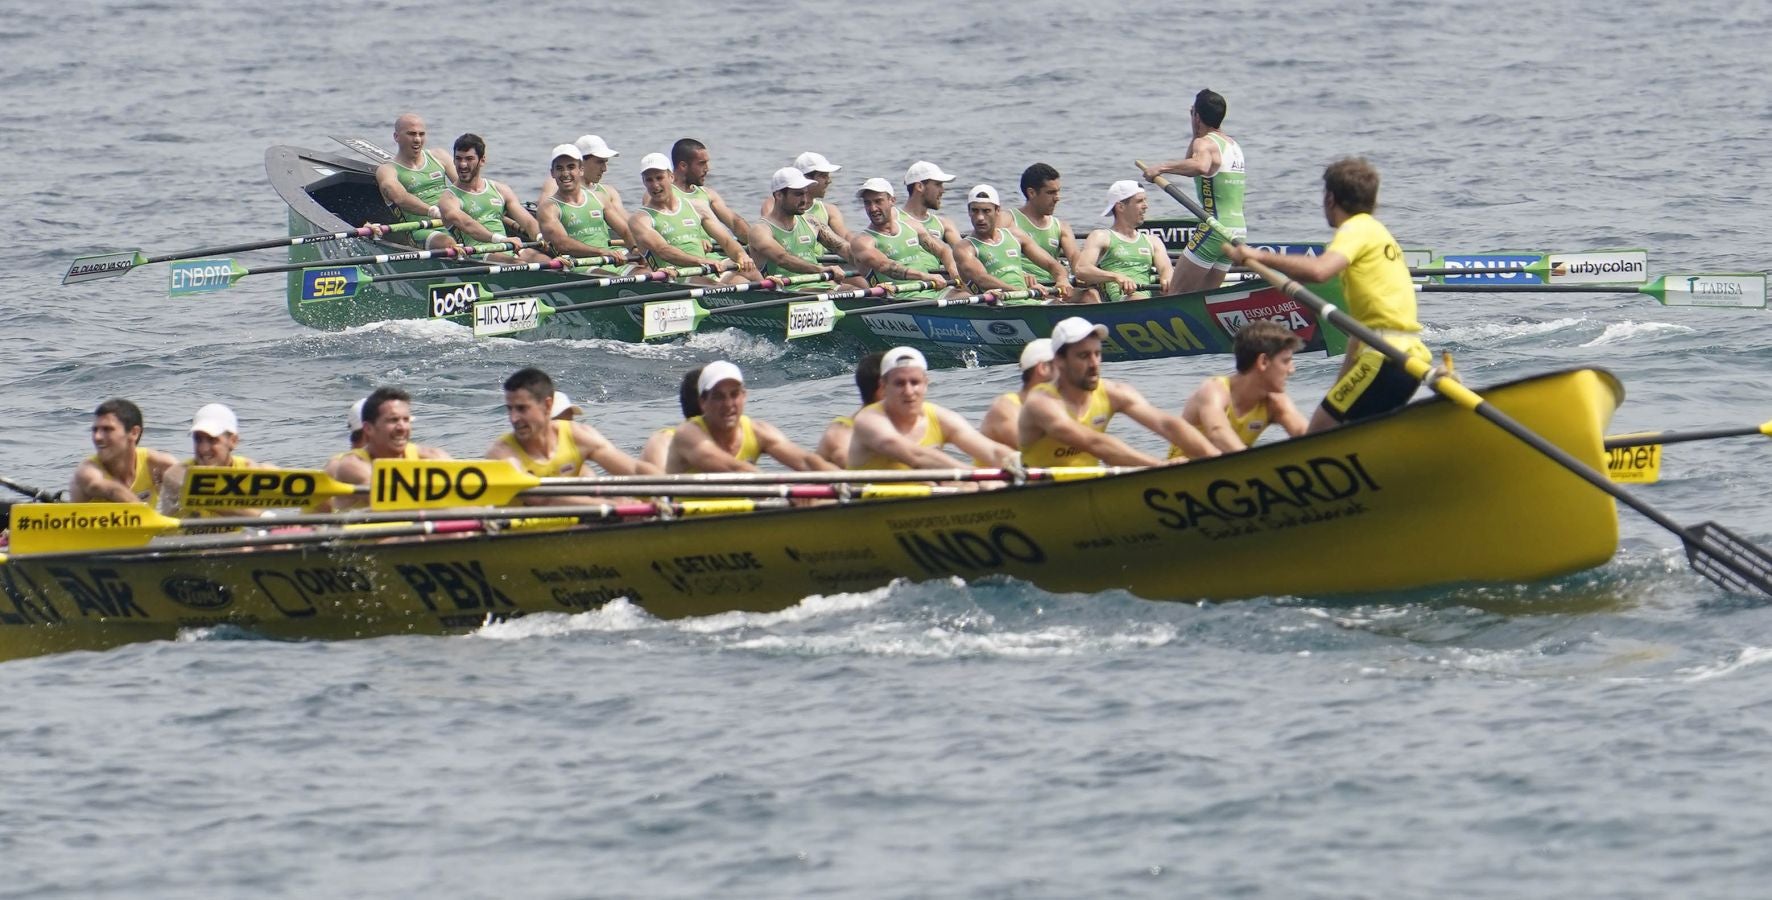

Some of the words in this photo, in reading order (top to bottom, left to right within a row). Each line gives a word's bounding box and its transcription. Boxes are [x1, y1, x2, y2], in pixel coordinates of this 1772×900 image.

[390, 252, 418, 261] MATRIX
[70, 266, 80, 274] EL
[81, 262, 106, 272] DIARIO
[107, 260, 131, 269] VASCO
[171, 265, 231, 289] ENBATA
[501, 265, 528, 273] MATRIX
[1570, 261, 1643, 275] urbycolan
[611, 277, 636, 285] MATRIX
[705, 286, 735, 296] MATRIX
[1700, 282, 1743, 295] TABISA
[476, 301, 538, 327] HIRUZTA
[1245, 308, 1272, 320] EUSKO
[1272, 300, 1301, 314] LABEL
[866, 317, 910, 333] ALKAIN
[188, 473, 316, 497] EXPO
[376, 466, 488, 502] INDO
[1143, 453, 1382, 530] SAGARDI
[17, 510, 142, 531] #nioriorekin
[893, 524, 1049, 575] INDO
[395, 560, 516, 613] PBX
